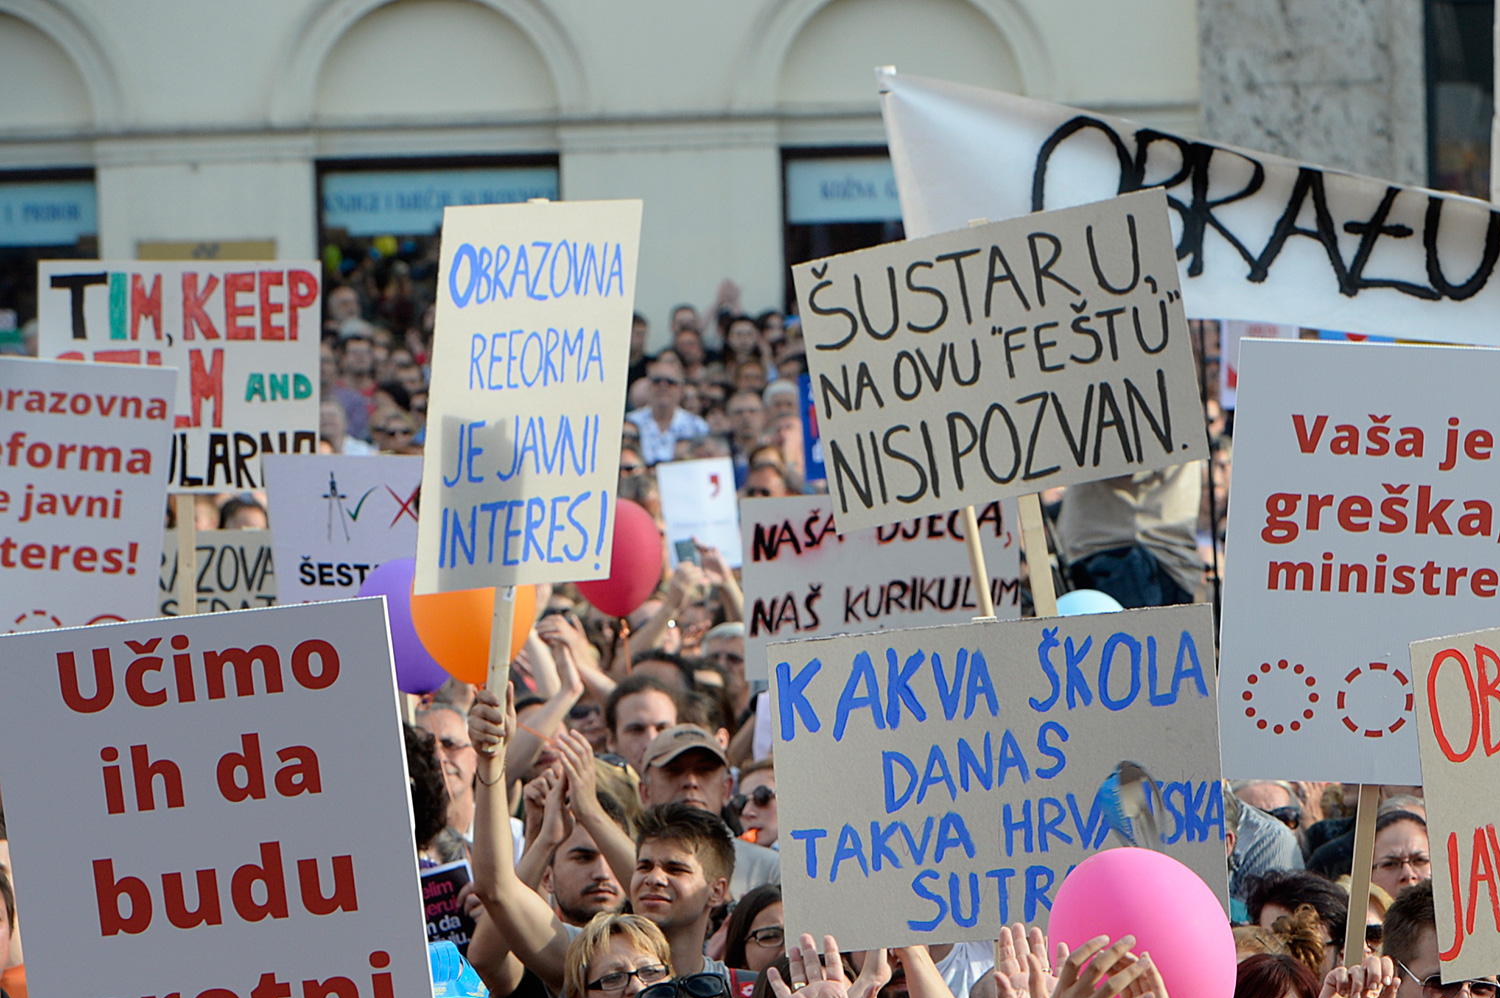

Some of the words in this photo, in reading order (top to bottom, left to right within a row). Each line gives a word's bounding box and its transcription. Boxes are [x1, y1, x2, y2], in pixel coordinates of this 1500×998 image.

[50, 270, 173, 347] TIM,
[182, 270, 319, 341] KEEP
[449, 239, 623, 309] OBRAZOVNA
[0, 389, 168, 421] razovna
[245, 373, 313, 403] AND
[819, 361, 885, 420] NA
[893, 338, 981, 401] OVU
[0, 432, 152, 475] forma
[443, 420, 487, 487] JE
[496, 414, 599, 481] JAVNI
[830, 420, 940, 513] NISI
[946, 368, 1189, 484] POZVAN.
[1291, 414, 1425, 458] Vaša
[1439, 417, 1494, 471] je
[18, 484, 123, 523] javni
[438, 490, 607, 570] INTERES!
[299, 555, 382, 586] ŠEST
[750, 583, 822, 637] NAŠ
[845, 576, 1020, 624] KURIKULM
[1267, 552, 1499, 599] ministre
[56, 634, 341, 714] Učimo
[774, 647, 1000, 742] KAKVA
[1028, 625, 1209, 713] ŠKOLA
[100, 744, 185, 815] ih
[216, 732, 323, 803] da
[882, 720, 1070, 814] DANAS
[791, 811, 975, 883] TAKVA
[92, 841, 359, 937] budu
[907, 863, 1077, 932] SUTR
